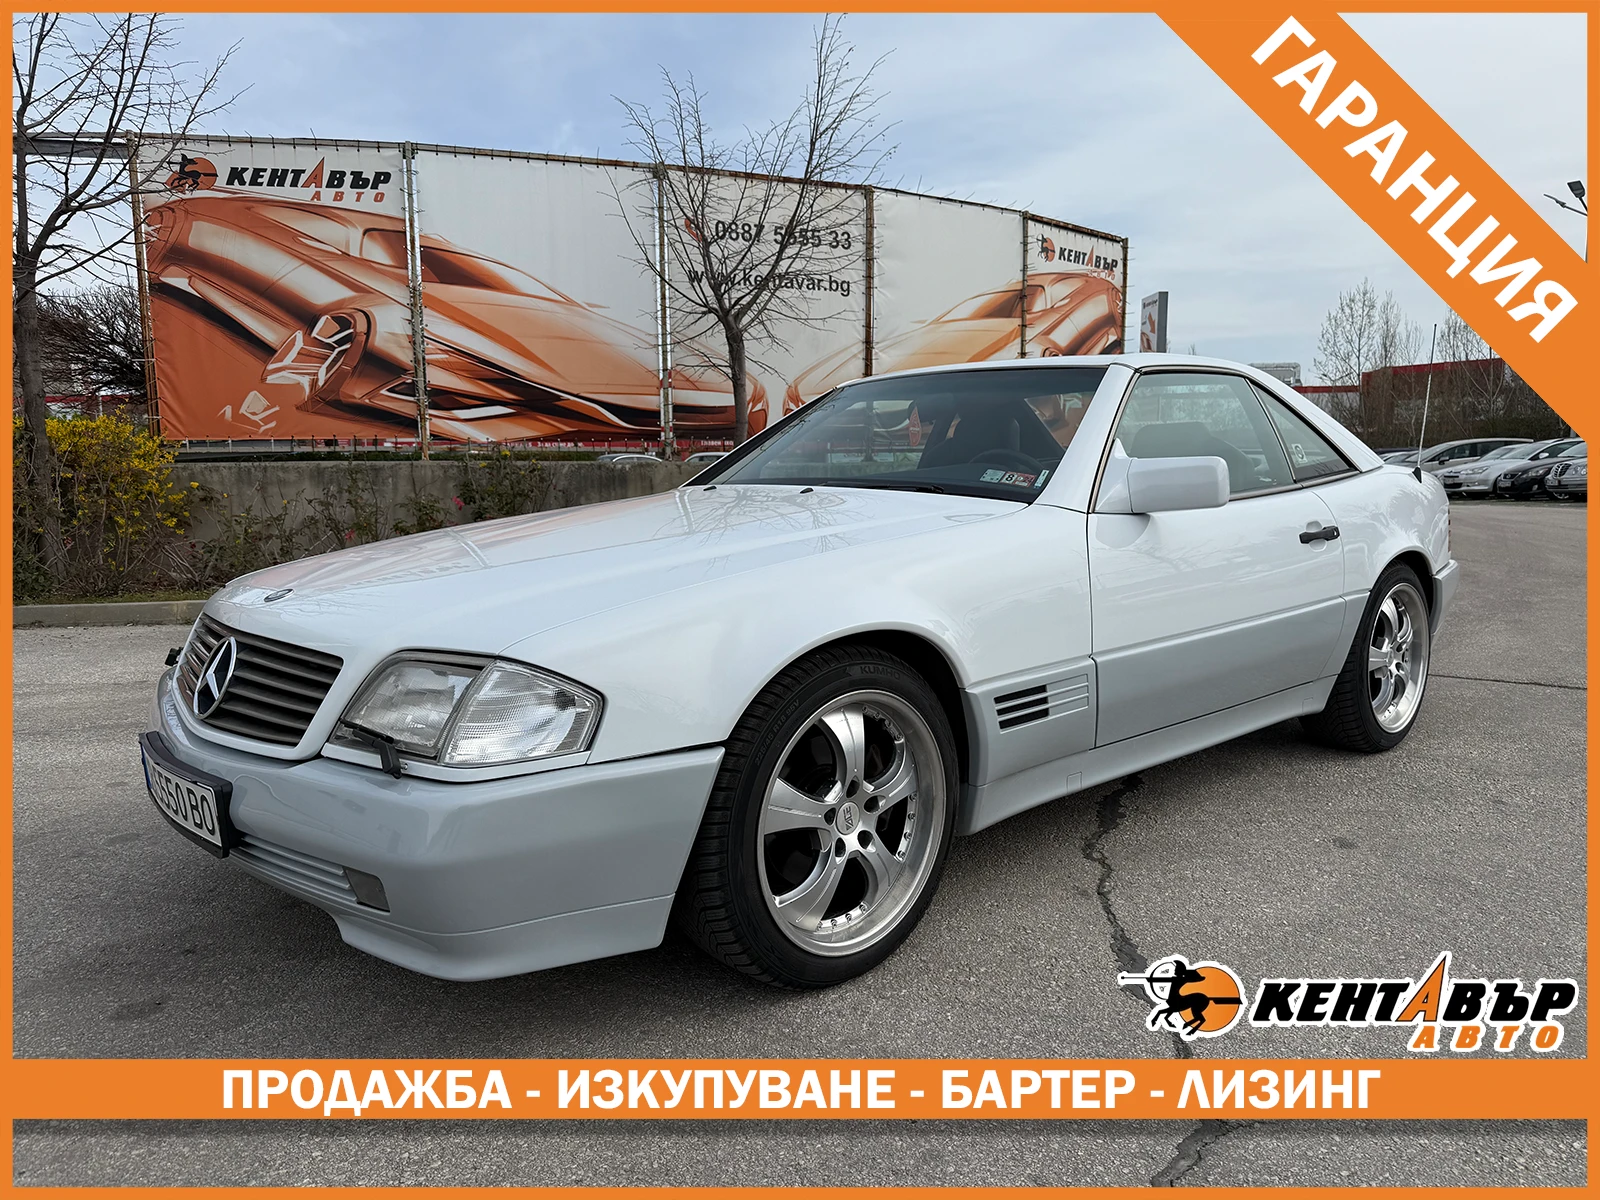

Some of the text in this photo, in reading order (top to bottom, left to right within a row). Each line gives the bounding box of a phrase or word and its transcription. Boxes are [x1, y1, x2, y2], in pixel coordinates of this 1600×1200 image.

[225, 157, 392, 190] КЕНТАВЪР
[310, 190, 385, 203] АВТО
[828, 230, 852, 250] 33
[1058, 245, 1119, 271] КЕНТАВЪР
[688, 267, 851, 297] ww.kenavar.bg
[1005, 473, 1015, 482] 8
[859, 665, 901, 680] KUMHO
